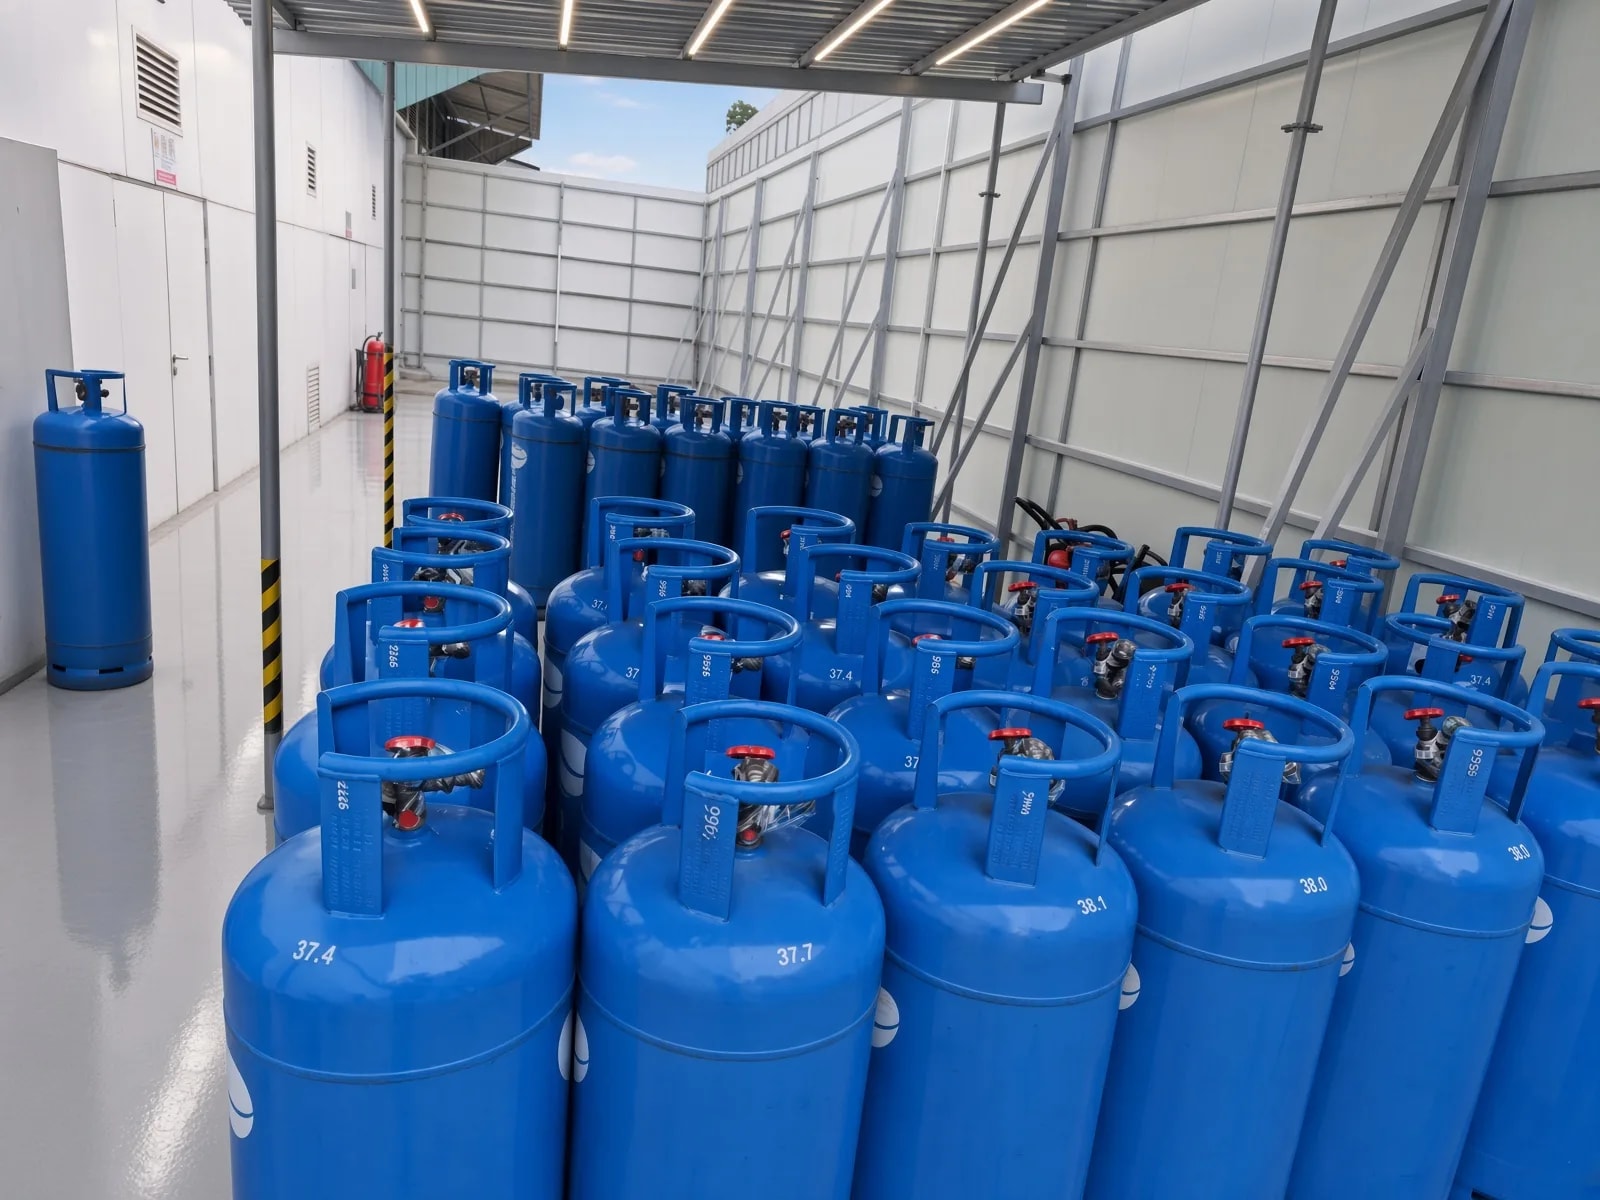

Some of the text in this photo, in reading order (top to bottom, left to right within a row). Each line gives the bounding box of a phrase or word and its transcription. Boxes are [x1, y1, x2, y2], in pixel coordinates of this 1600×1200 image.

[592, 599, 608, 610] 37.
[830, 669, 852, 681] 37.4
[1470, 674, 1491, 686] 37.4
[1508, 844, 1531, 861] 38.0
[1300, 877, 1328, 894] 38.0
[1077, 896, 1107, 915] 38.1
[293, 940, 336, 965] 37.4
[777, 943, 813, 966] 37.7
